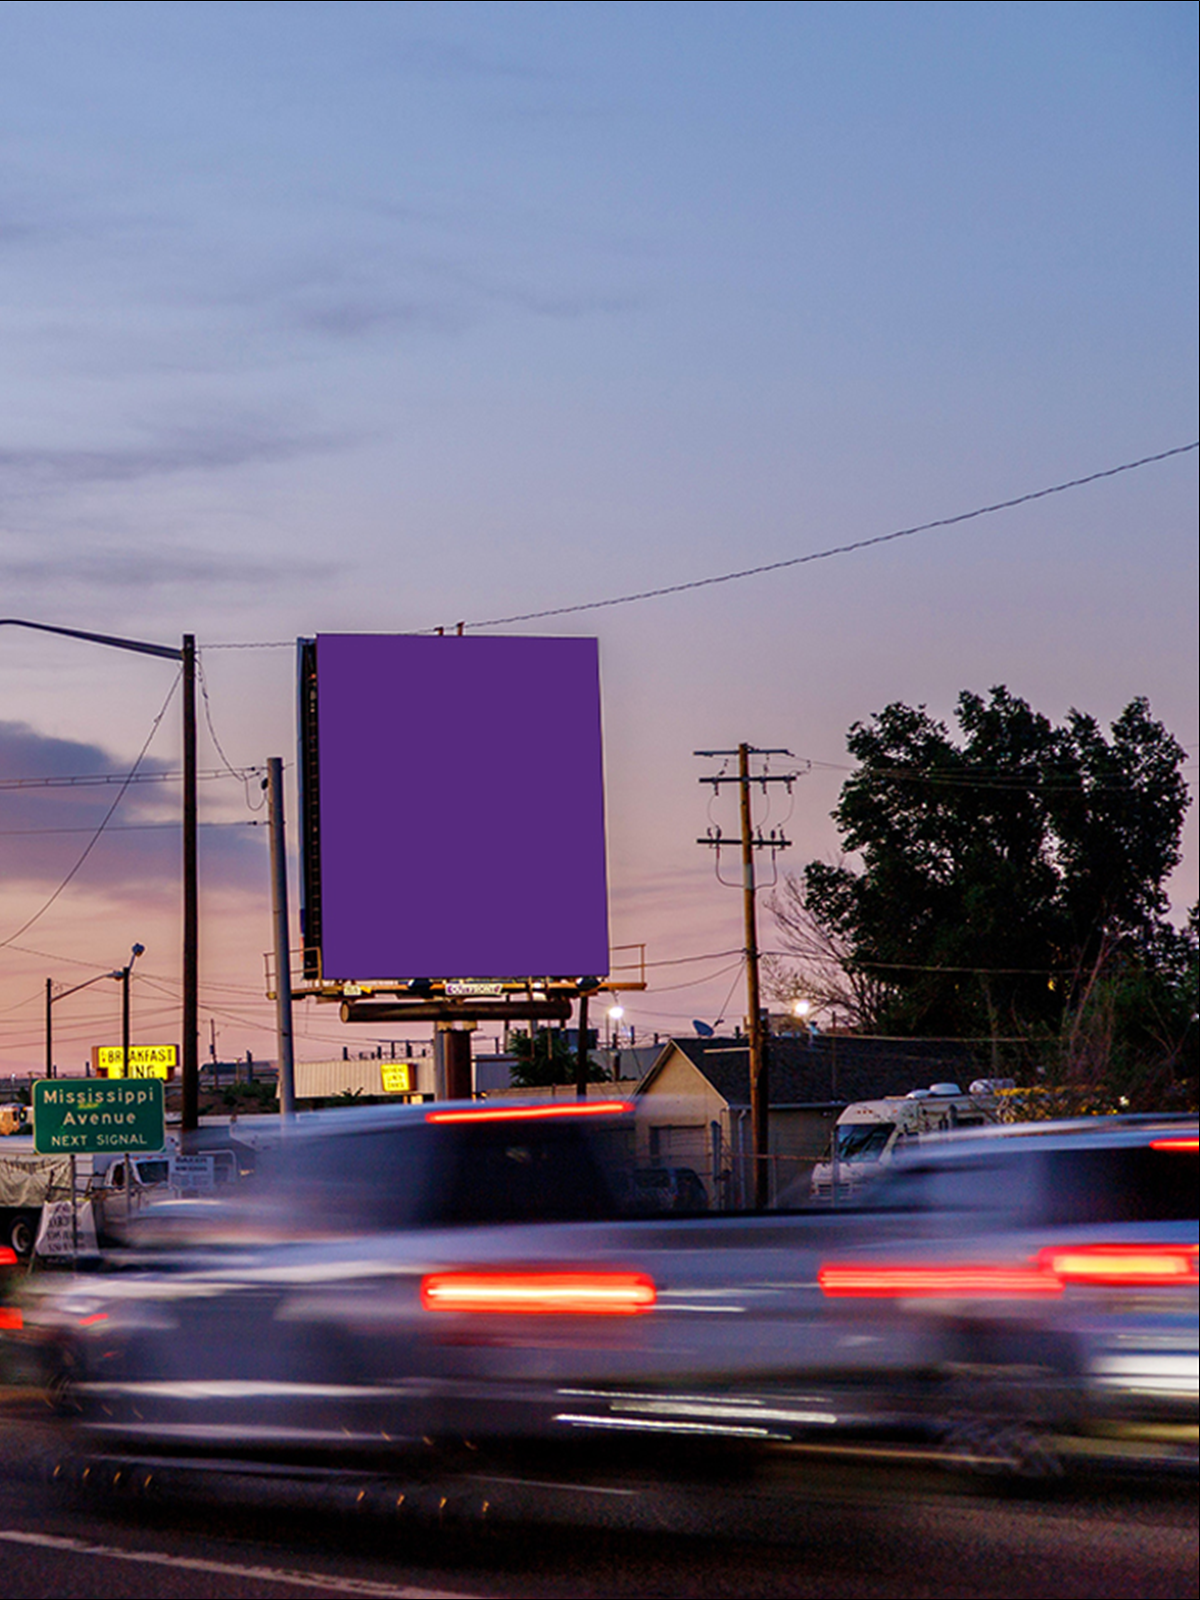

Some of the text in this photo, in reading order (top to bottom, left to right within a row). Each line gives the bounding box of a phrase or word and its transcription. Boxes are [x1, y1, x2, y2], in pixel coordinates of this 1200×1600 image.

[108, 1048, 173, 1064] BRAKFAST
[43, 1087, 154, 1105] Mississippi
[62, 1111, 136, 1126] Avenue
[51, 1133, 147, 1147] NEXT SIGNAL
